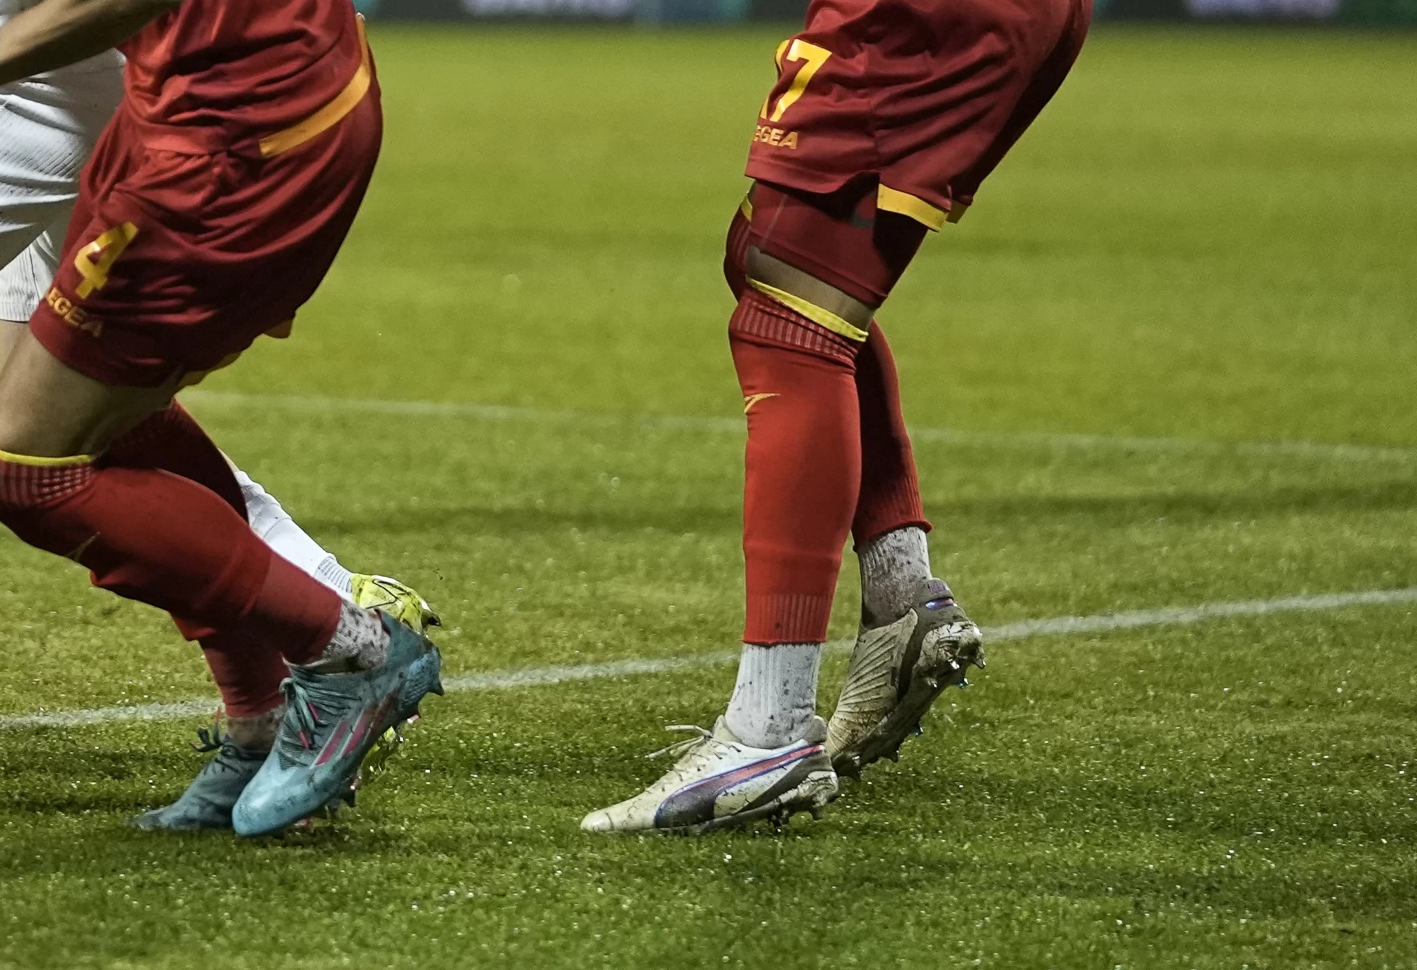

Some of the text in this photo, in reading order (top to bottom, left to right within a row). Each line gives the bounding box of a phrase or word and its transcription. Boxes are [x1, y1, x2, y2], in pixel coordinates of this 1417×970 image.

[753, 124, 799, 151] EGEA
[74, 222, 138, 299] 4
[45, 286, 105, 339] EGEA
